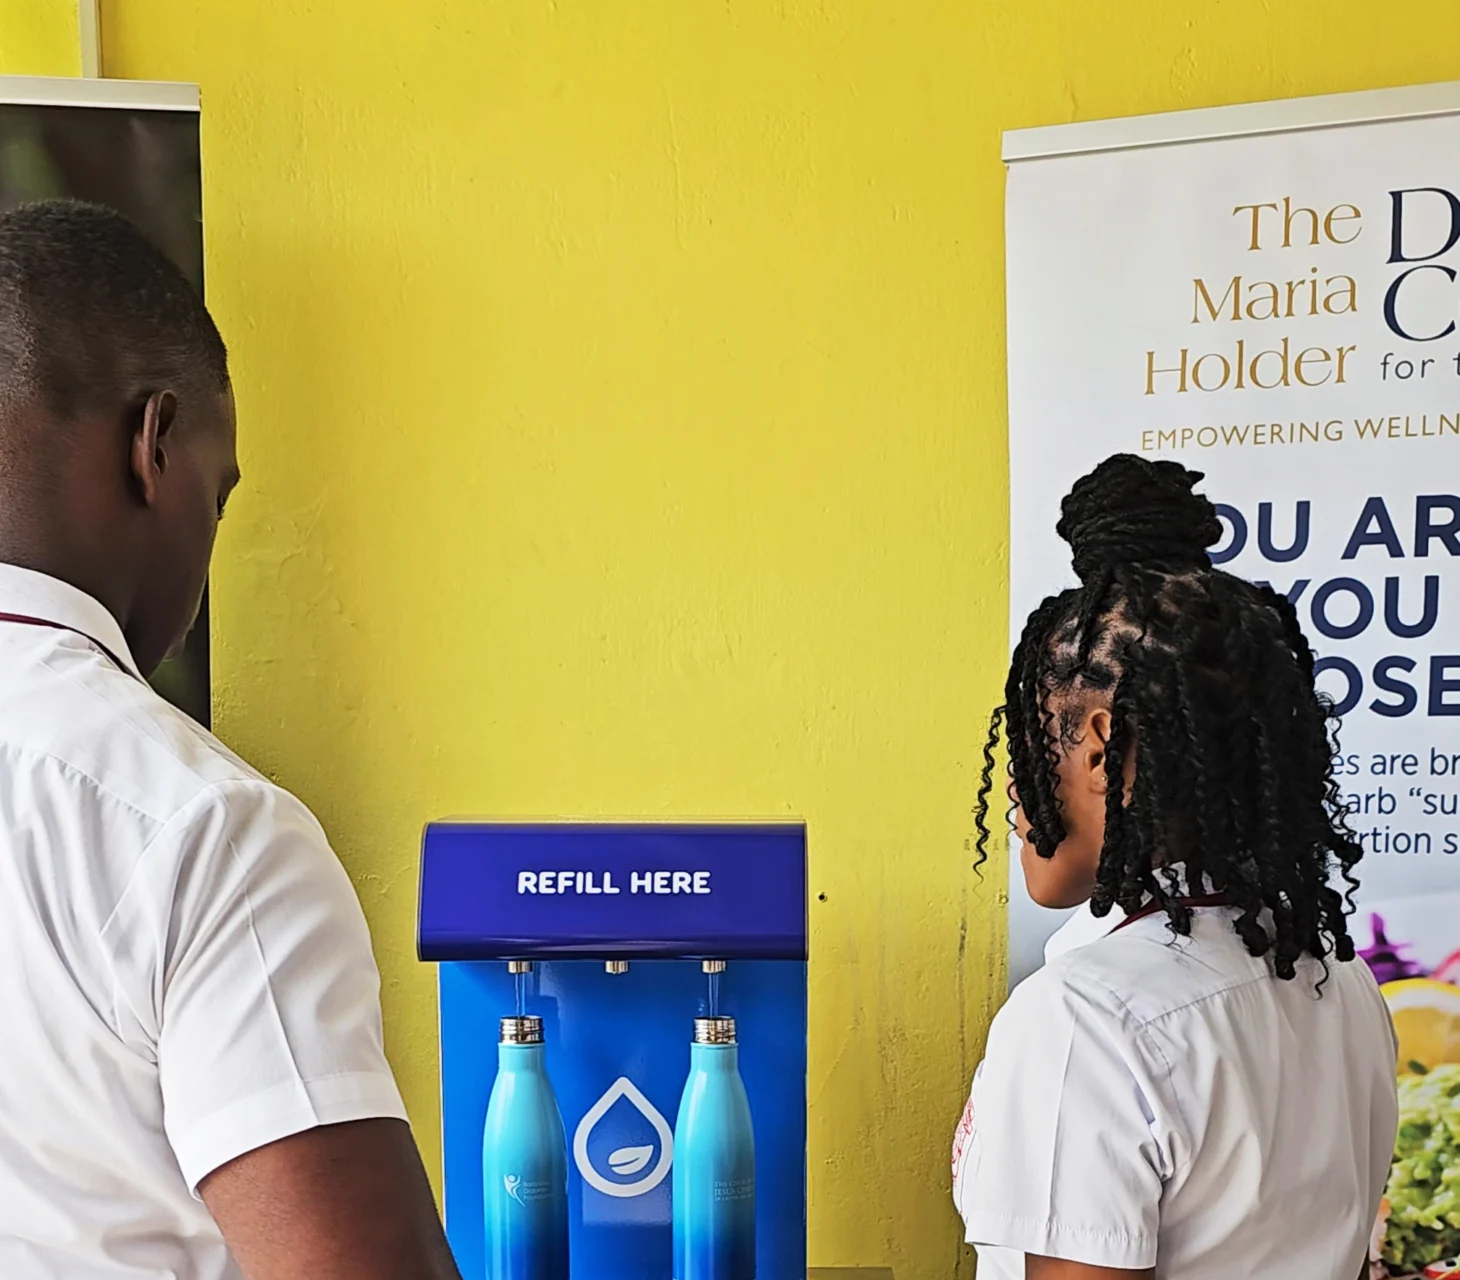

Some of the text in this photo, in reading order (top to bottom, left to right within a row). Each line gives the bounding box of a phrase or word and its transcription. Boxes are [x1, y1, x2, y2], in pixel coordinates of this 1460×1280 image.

[1232, 197, 1363, 251] The
[1385, 187, 1460, 264] D
[1191, 267, 1358, 324] Maria
[1144, 337, 1357, 396] Holder
[1380, 353, 1435, 380] for
[1141, 419, 1344, 451] EMPOWERING
[1370, 754, 1419, 776] are
[517, 871, 712, 895] REFILL HERE
